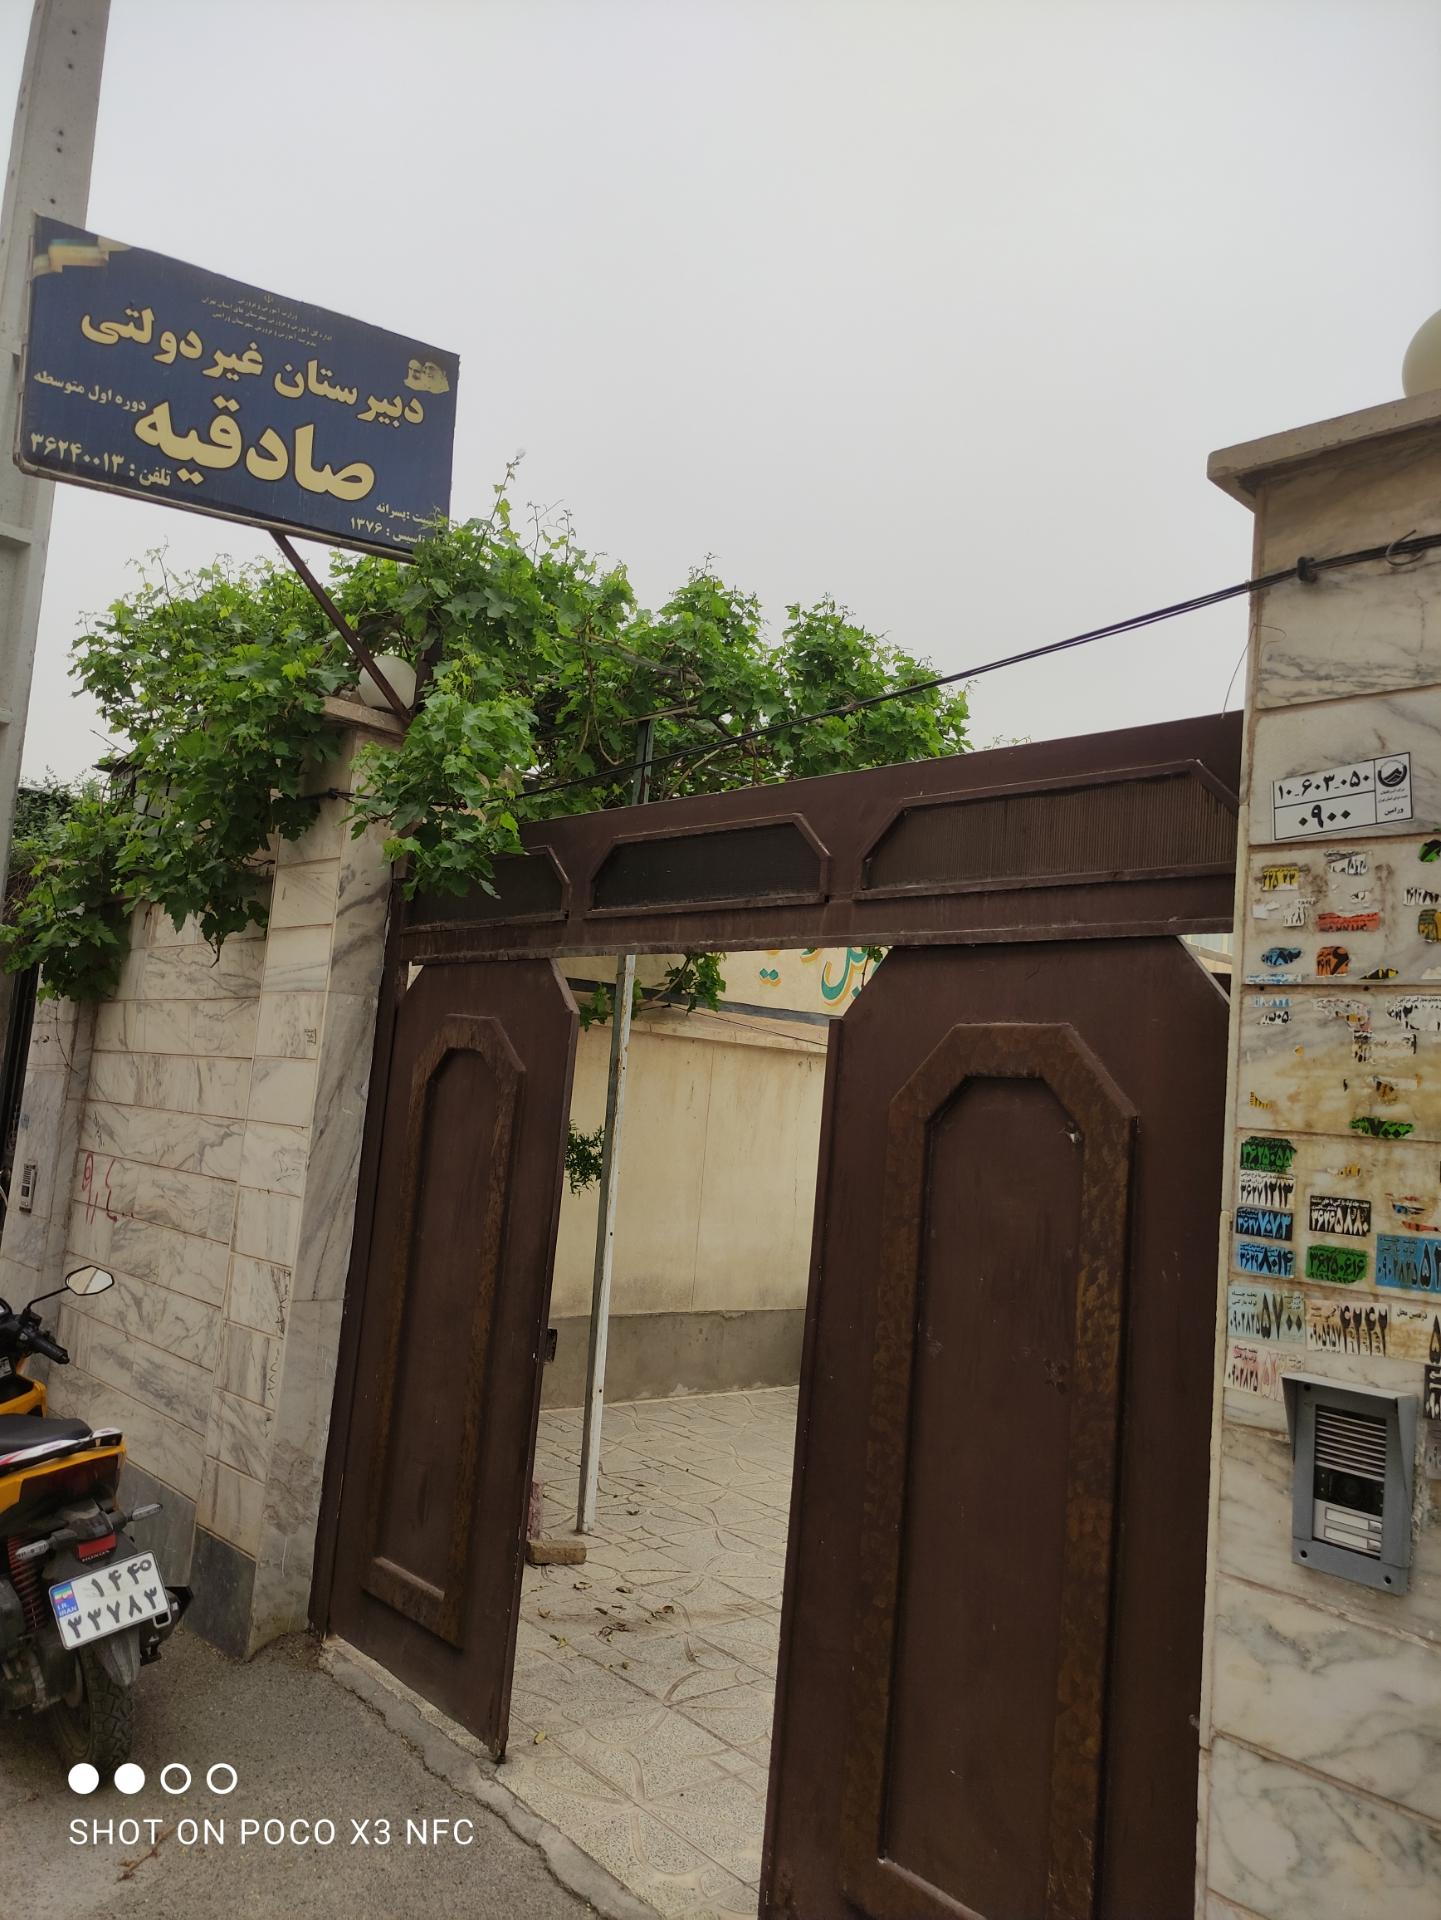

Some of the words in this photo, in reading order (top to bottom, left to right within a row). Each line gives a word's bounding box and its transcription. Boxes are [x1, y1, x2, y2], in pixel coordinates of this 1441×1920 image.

[33, 370, 86, 394] متوسطه
[87, 384, 113, 404] اول
[273, 359, 425, 428] دبیرستان
[115, 395, 147, 412] دوره
[30, 432, 125, 474] ۳۶۲۴۰۰۱۳
[134, 394, 376, 502] صادقیه
[350, 517, 383, 534] ۱۳۷۶
[1298, 804, 1351, 828] ۰۹۰۰
[59, 1606, 78, 1617] IRAN
[67, 1586, 158, 1639] ۳۳۷۸۳
